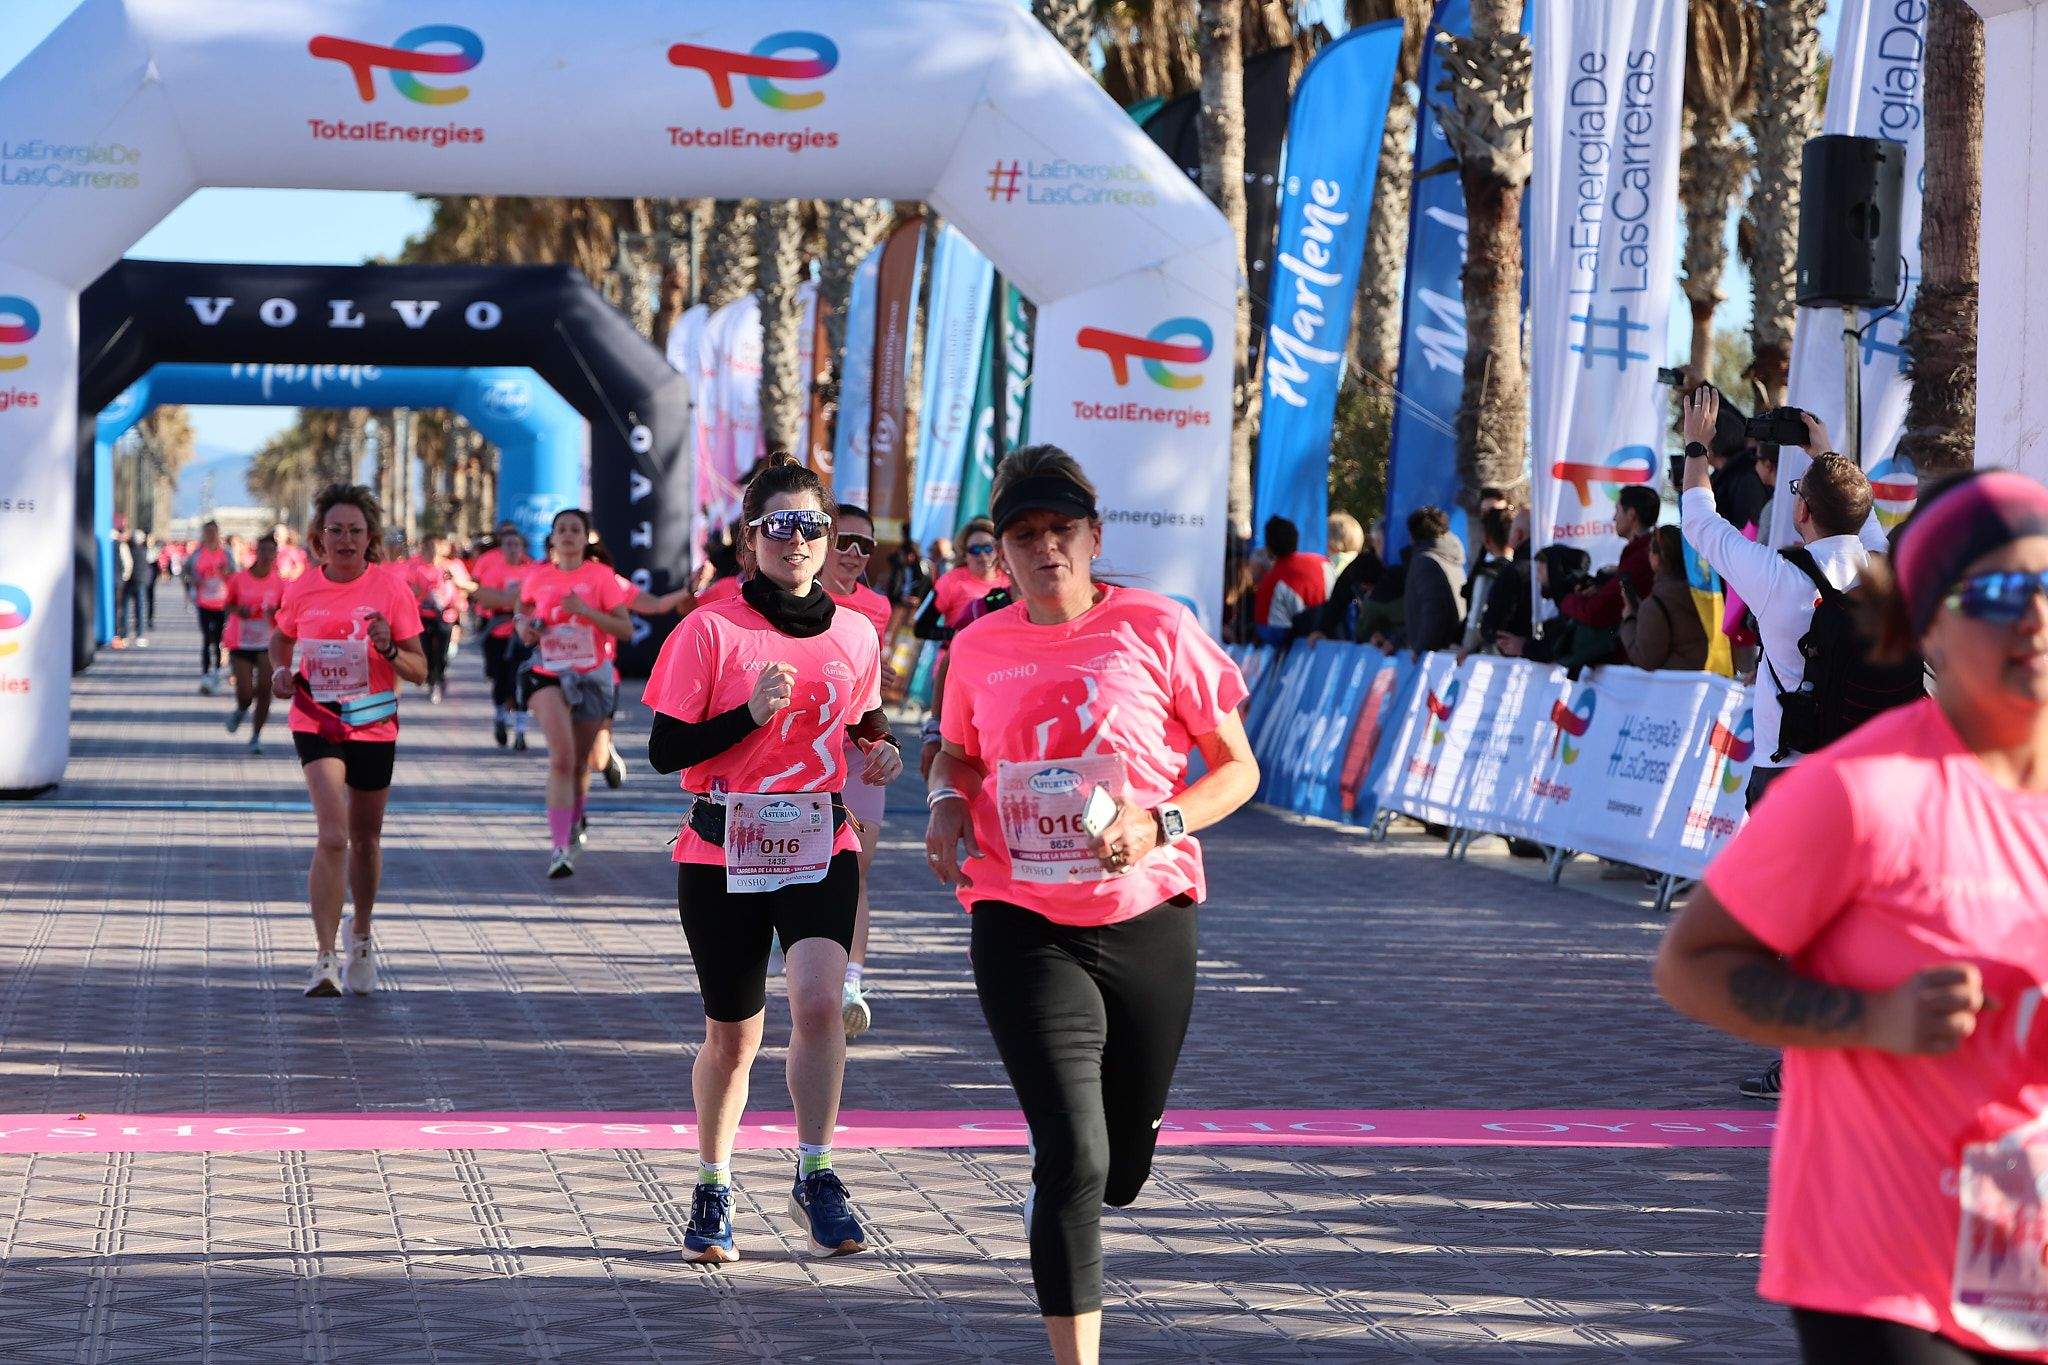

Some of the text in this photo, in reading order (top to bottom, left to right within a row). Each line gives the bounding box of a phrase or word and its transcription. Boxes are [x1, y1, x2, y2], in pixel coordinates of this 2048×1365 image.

[308, 119, 486, 148] TotalEnergies
[667, 127, 839, 153] TotalEnergies
[1569, 51, 1611, 294] LaEnergíaDe
[1611, 50, 1655, 293] LasCarreras
[1267, 179, 1349, 407] Marlene
[186, 297, 502, 330] VOLVO
[1073, 401, 1211, 428] TotalEnergies
[986, 662, 1038, 685] OYSHO
[762, 809, 798, 818] ASTURIANA
[1038, 813, 1084, 835] 016
[760, 838, 800, 854] 016
[737, 878, 767, 887] OYSHO
